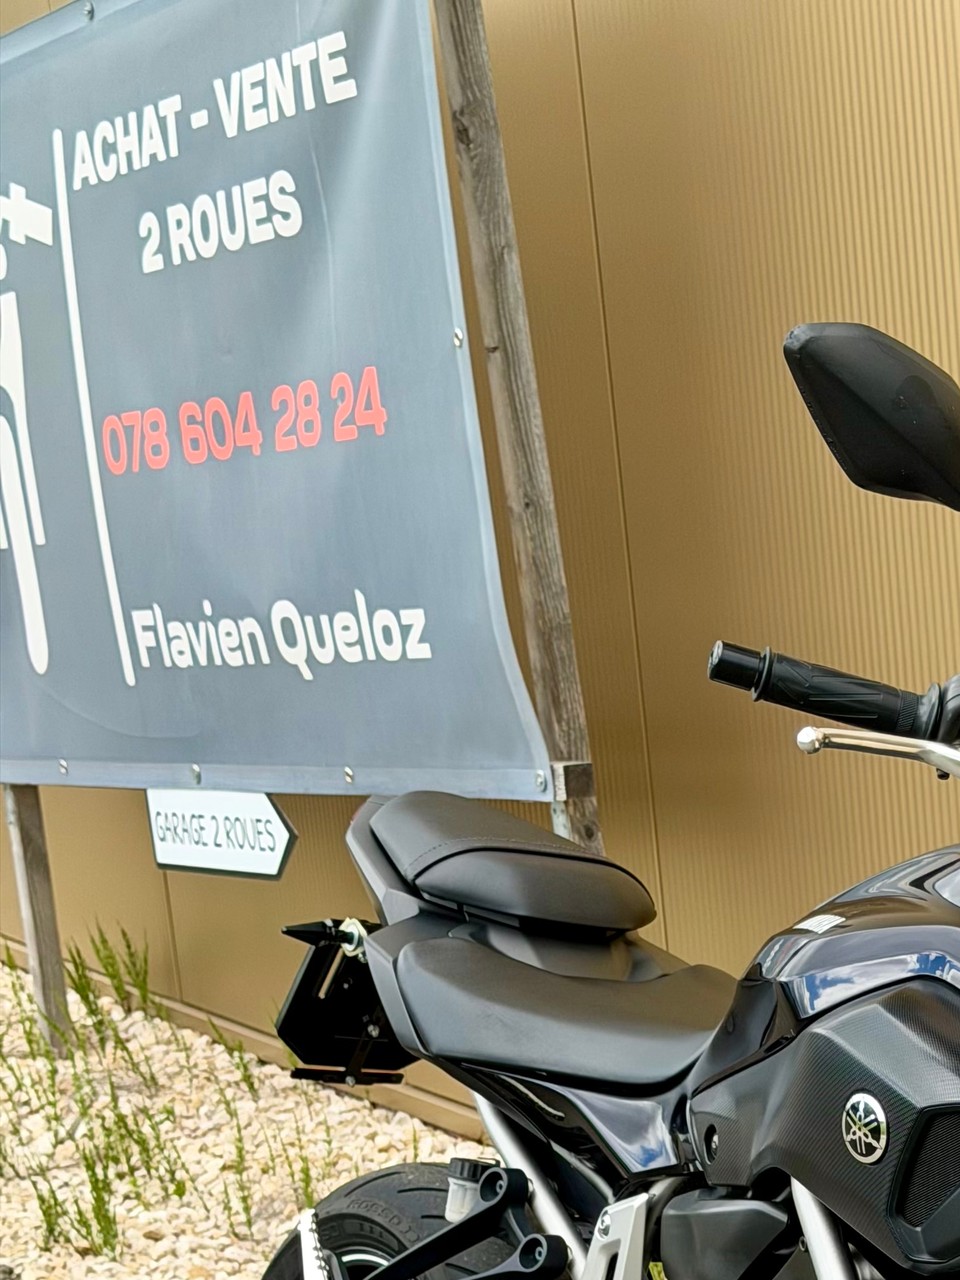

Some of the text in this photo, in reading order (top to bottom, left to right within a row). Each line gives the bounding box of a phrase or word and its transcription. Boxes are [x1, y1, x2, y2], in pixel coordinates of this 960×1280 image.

[72, 31, 358, 191] ACHAT - VENTE
[138, 169, 303, 274] 2 ROUES
[102, 367, 387, 475] 078 604 28 24
[131, 589, 432, 680] Flavien Queloz
[154, 810, 277, 853] GARAGE 2 ROUES
